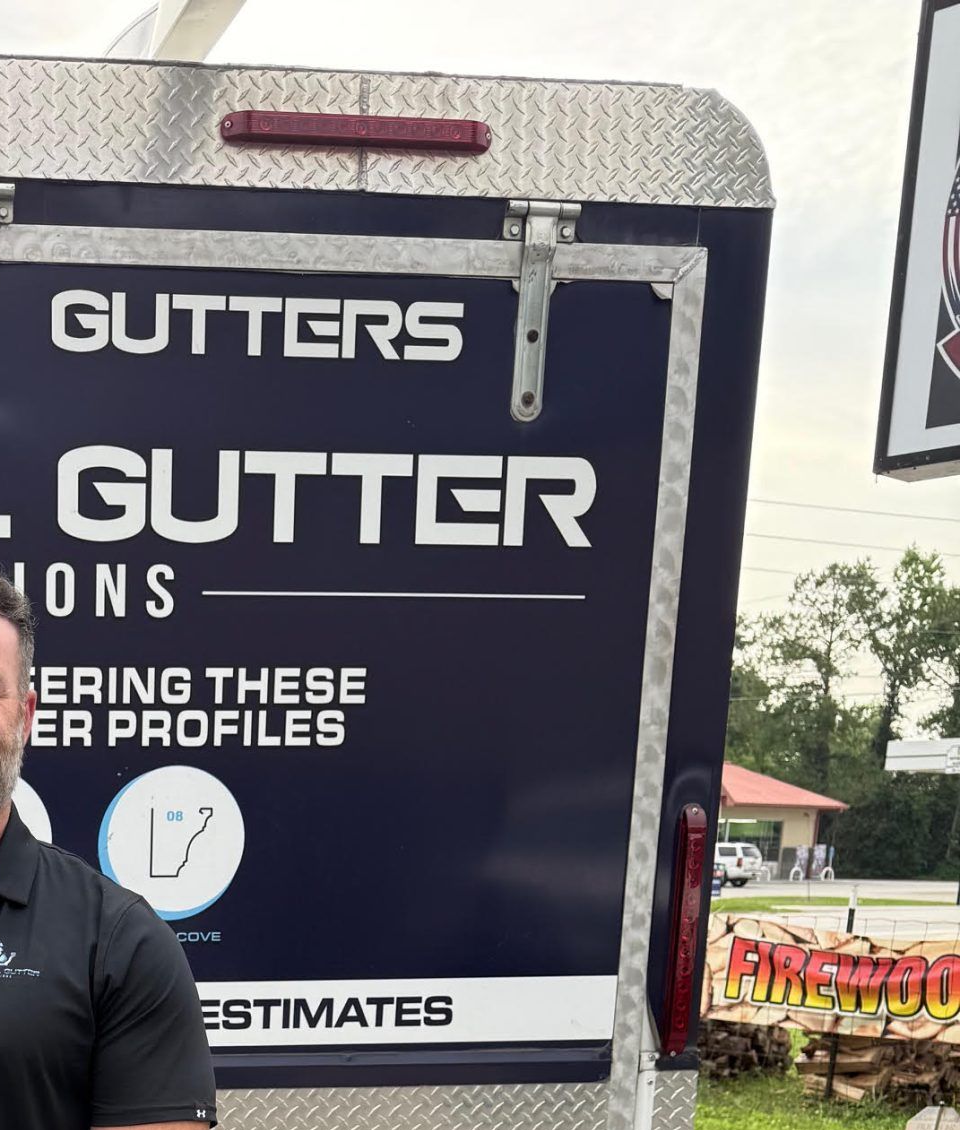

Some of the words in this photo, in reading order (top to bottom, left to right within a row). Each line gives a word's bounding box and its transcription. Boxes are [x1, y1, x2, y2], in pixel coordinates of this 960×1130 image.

[51, 289, 464, 361] GUTTERS
[57, 445, 597, 548] GUTTER
[205, 667, 367, 704] THESE
[108, 709, 345, 747] PROFILES
[167, 810, 184, 822] 08
[176, 931, 221, 943] COVE
[202, 995, 453, 1030] ESTIMATES
